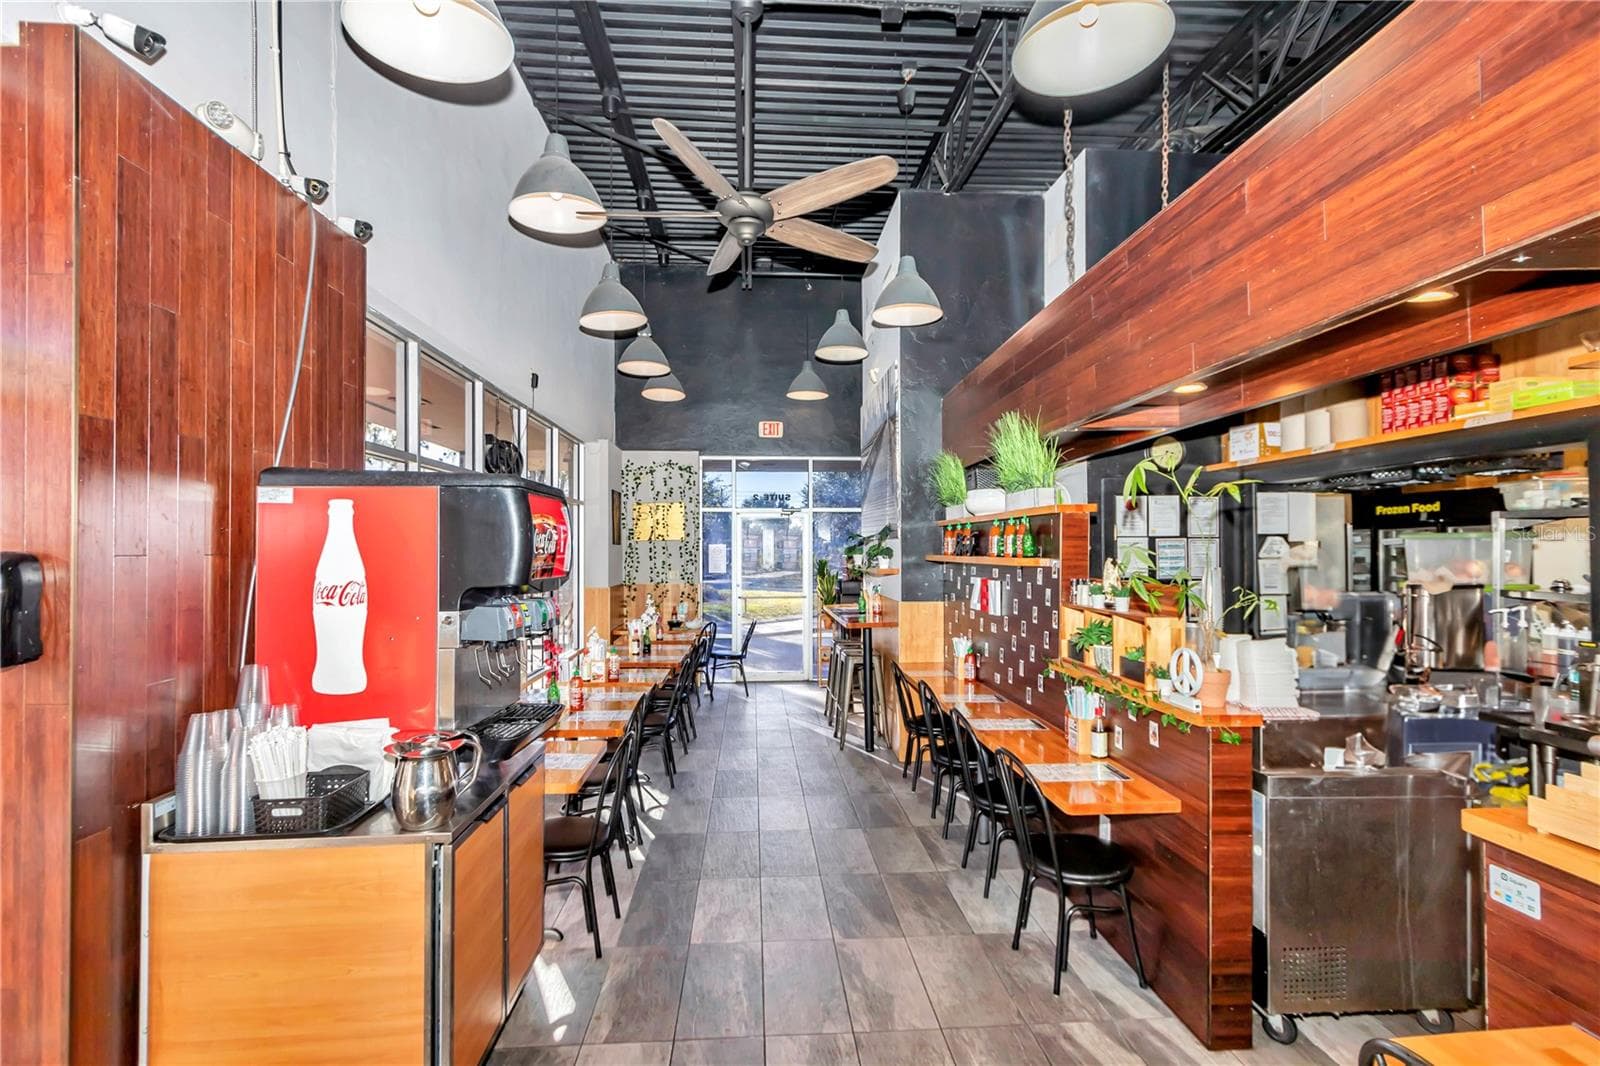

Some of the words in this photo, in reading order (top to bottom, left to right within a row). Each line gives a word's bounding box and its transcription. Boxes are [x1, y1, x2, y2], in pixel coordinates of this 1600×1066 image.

[762, 422, 780, 436] EXIT
[1375, 505, 1410, 516] Frozen
[1411, 501, 1441, 514] Food
